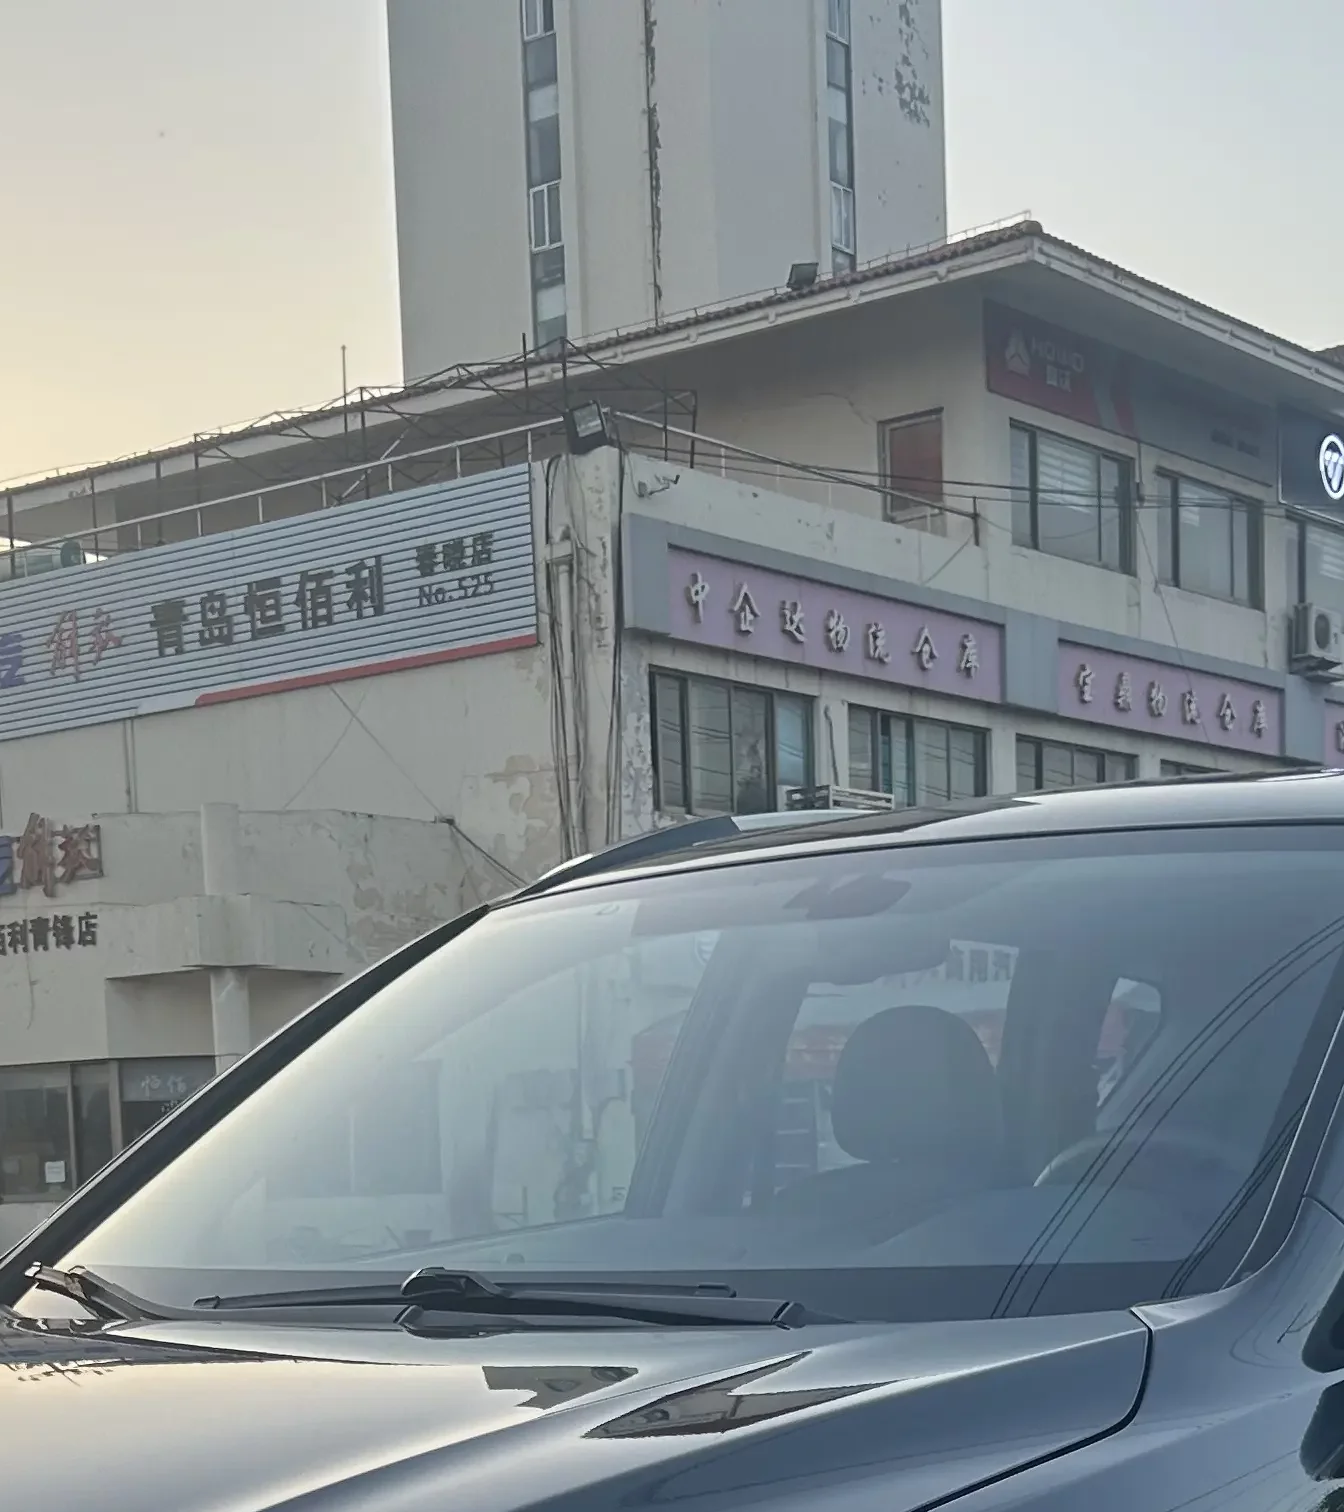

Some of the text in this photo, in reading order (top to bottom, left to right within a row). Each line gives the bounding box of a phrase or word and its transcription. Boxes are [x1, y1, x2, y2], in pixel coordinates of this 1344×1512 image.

[150, 555, 384, 656] 青岛恒佰利
